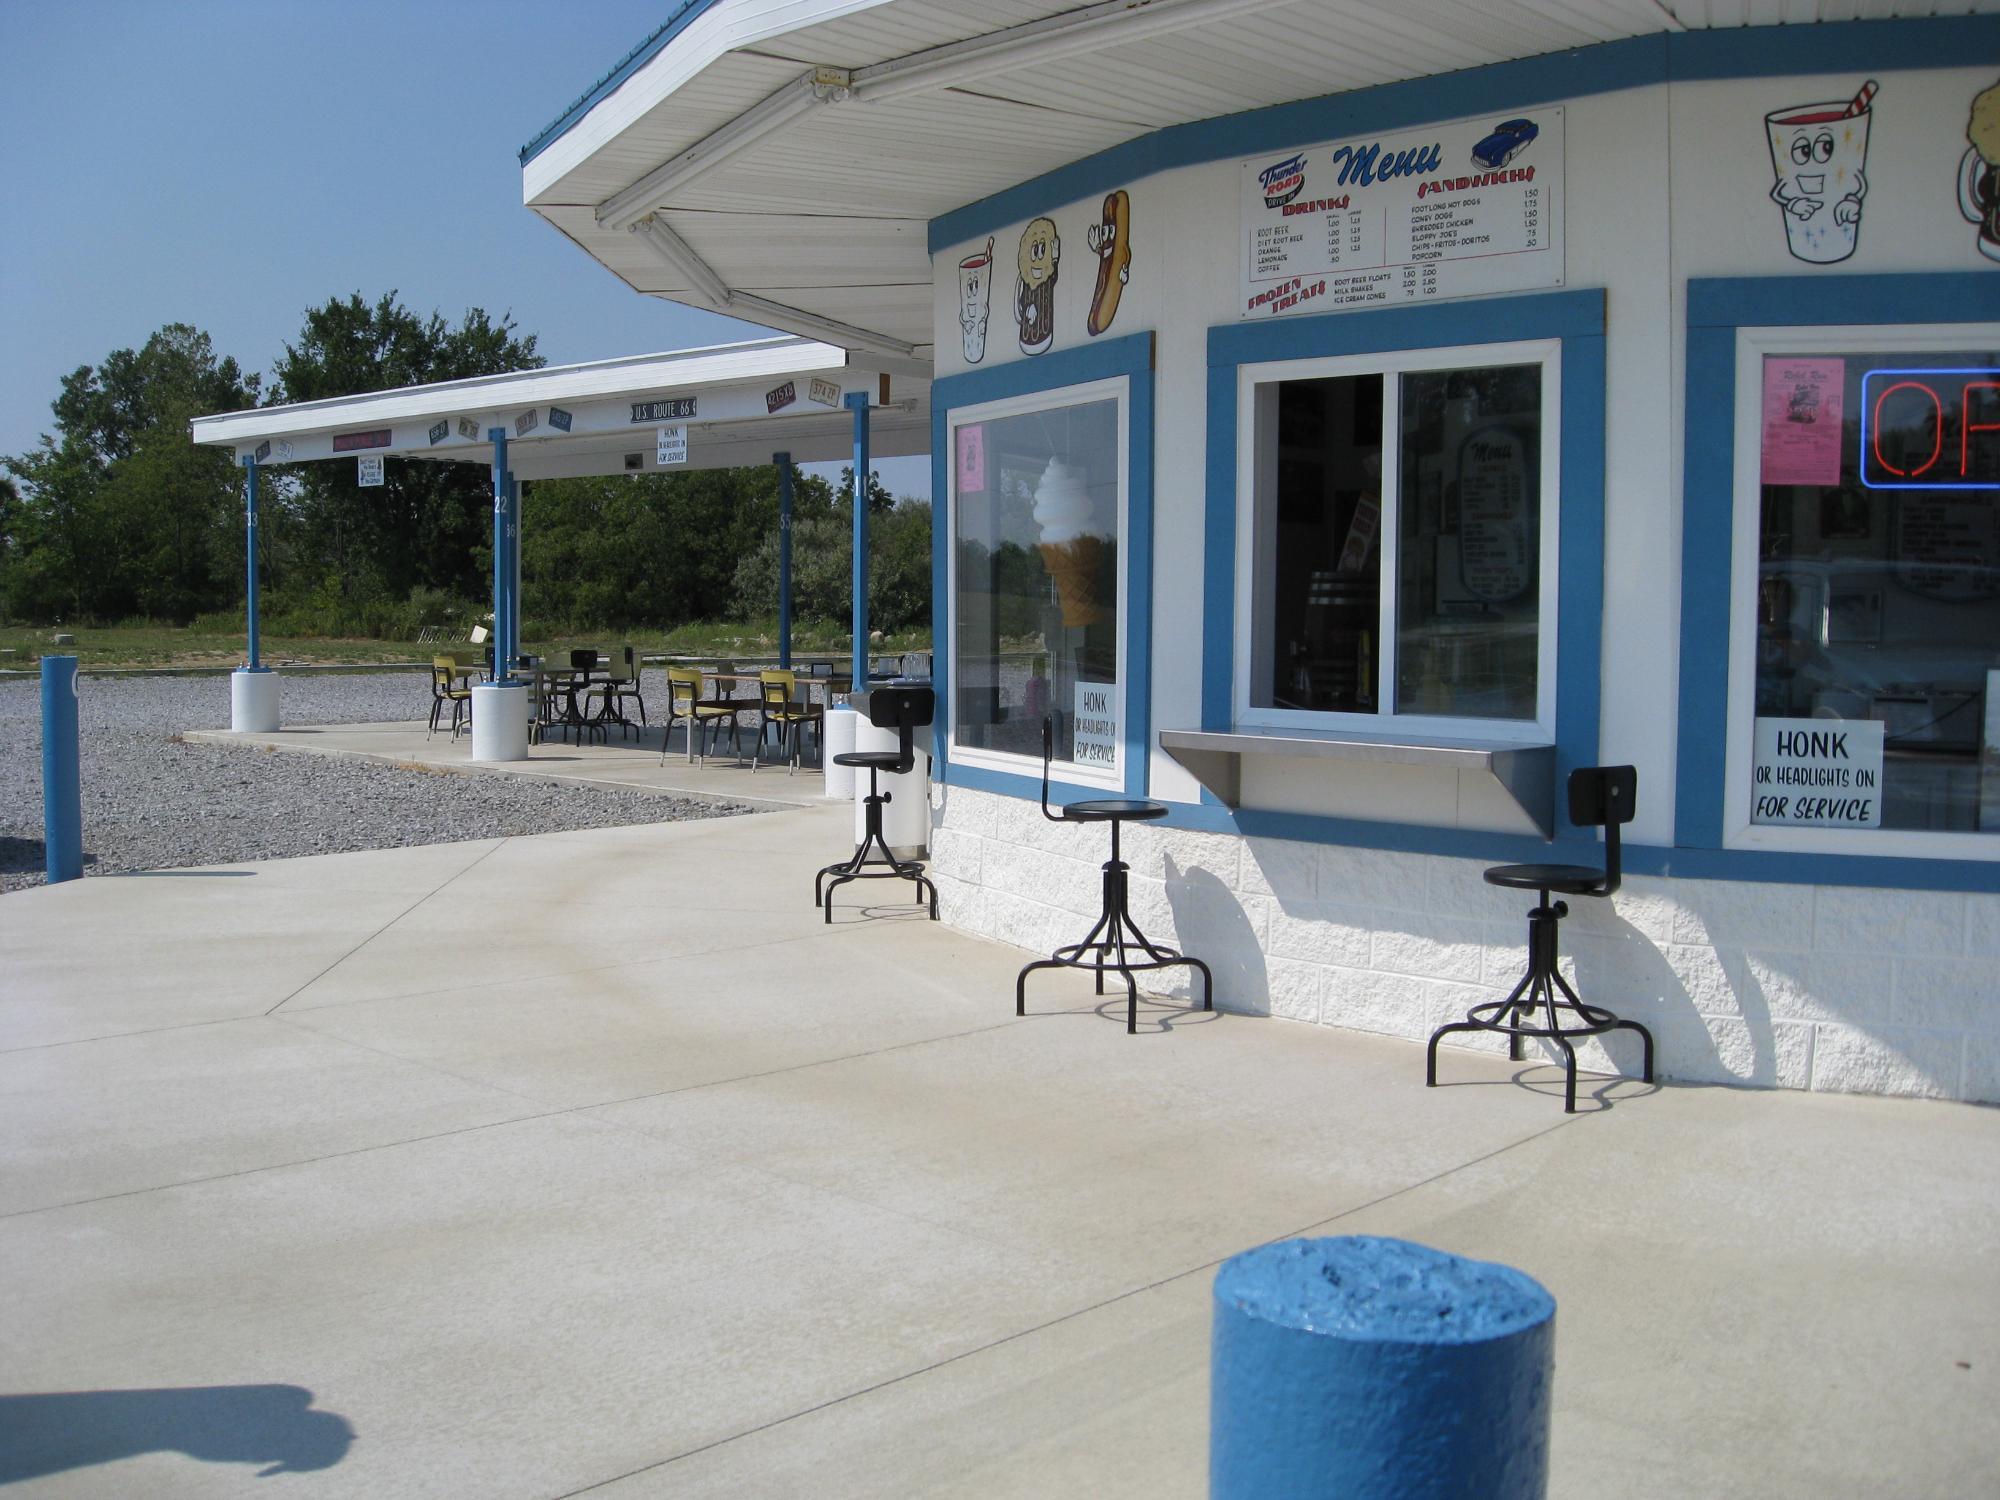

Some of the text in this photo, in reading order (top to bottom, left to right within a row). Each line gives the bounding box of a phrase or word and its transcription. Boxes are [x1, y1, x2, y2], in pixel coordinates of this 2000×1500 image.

[1258, 152, 1308, 190] Thunder
[1333, 143, 1442, 187] Menu
[1267, 173, 1303, 196] ROAD
[1417, 165, 1536, 199] SANDWICHS
[1282, 194, 1350, 216] DRINKS
[1447, 200, 1461, 209] HOT
[1462, 198, 1481, 208] DOGS
[1411, 214, 1432, 224] CONEY
[1434, 211, 1454, 221] DOGS
[1411, 222, 1445, 233] SHREDDED
[1446, 217, 1474, 229] CHICKEN
[1274, 225, 1289, 235] BEER
[1411, 233, 1437, 242] SLOPPY
[1257, 247, 1281, 256] ORANGE
[1257, 254, 1288, 265] LEMONADE
[1411, 250, 1443, 261] POPCORN
[1257, 264, 1281, 273] COFFEE
[1334, 277, 1350, 286] ROOT
[1351, 275, 1367, 284] BEER
[1367, 272, 1391, 283] FLOATS
[1248, 278, 1302, 311] FROZEN
[1271, 279, 1327, 314] TREATS
[1334, 286, 1349, 295] MILK
[1350, 283, 1374, 293] SHAKES
[1334, 296, 1344, 304] ICE
[1345, 293, 1366, 303] CREAM
[1366, 291, 1386, 302] CONES
[635, 400, 690, 421] U.S. ROUTE 66
[495, 496, 507, 513] 22
[1083, 691, 1107, 713] HONK
[1076, 740, 1116, 764] FOR SERVICE
[1776, 730, 1850, 760] HONK
[1755, 766, 1875, 789] OR HEADLIGHTS ON
[1755, 797, 1871, 823] FOR SERVICE
